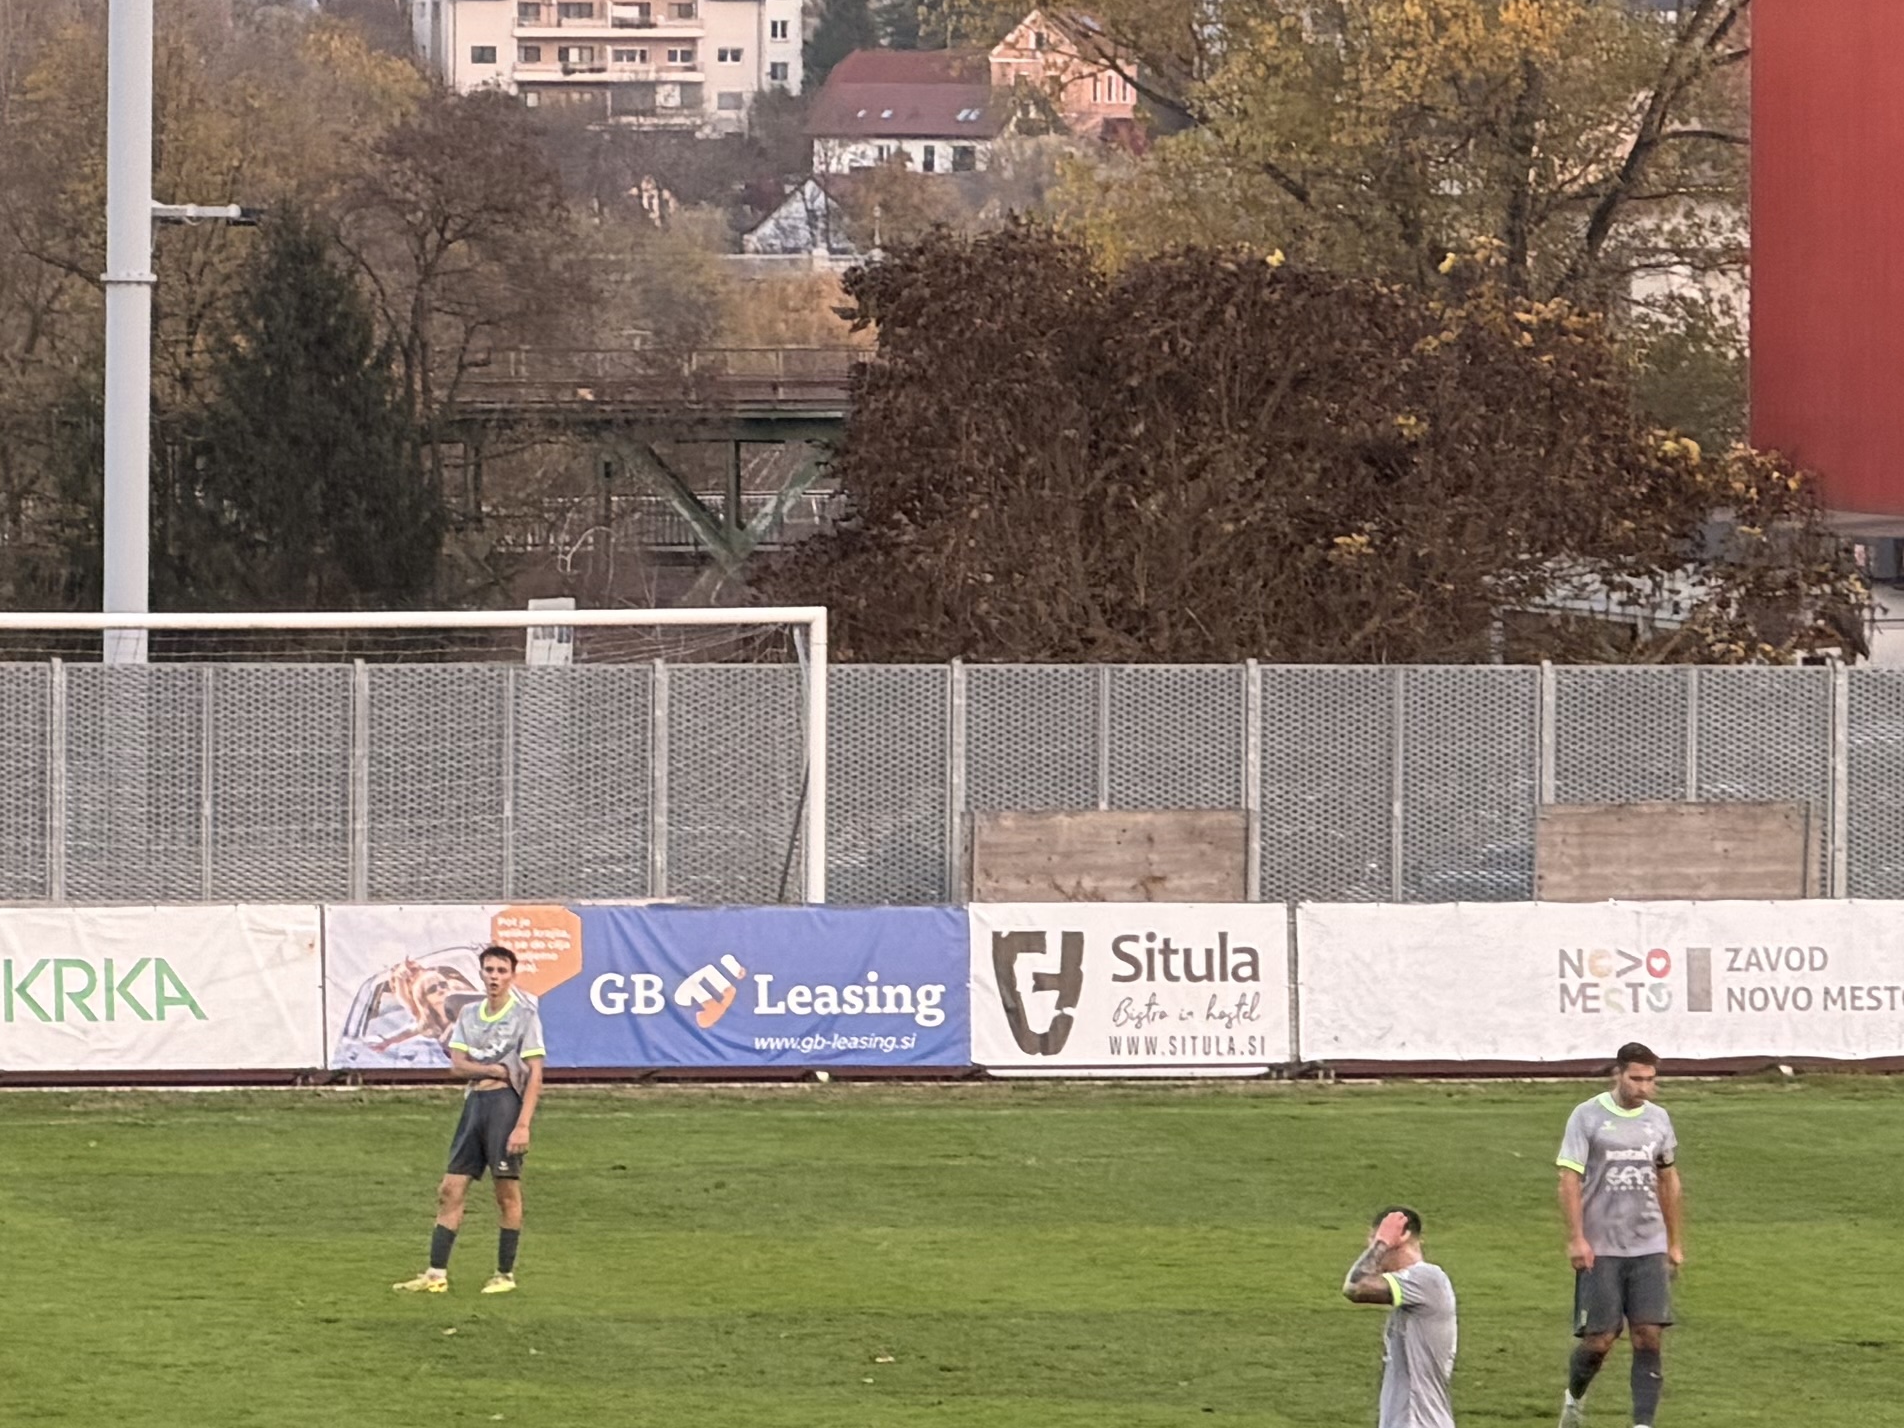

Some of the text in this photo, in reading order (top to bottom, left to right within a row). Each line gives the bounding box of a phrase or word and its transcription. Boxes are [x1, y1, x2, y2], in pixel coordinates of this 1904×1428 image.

[1111, 931, 1261, 983] Situla
[1725, 945, 1829, 973] ZAVOD
[3, 957, 209, 1022] KRKA
[589, 971, 947, 1027] GB Leasing
[1726, 985, 1813, 1013] NOVO
[753, 1032, 918, 1053] www.gb-leasing.si
[1109, 1035, 1266, 1057] WWW.SITULA.SI
